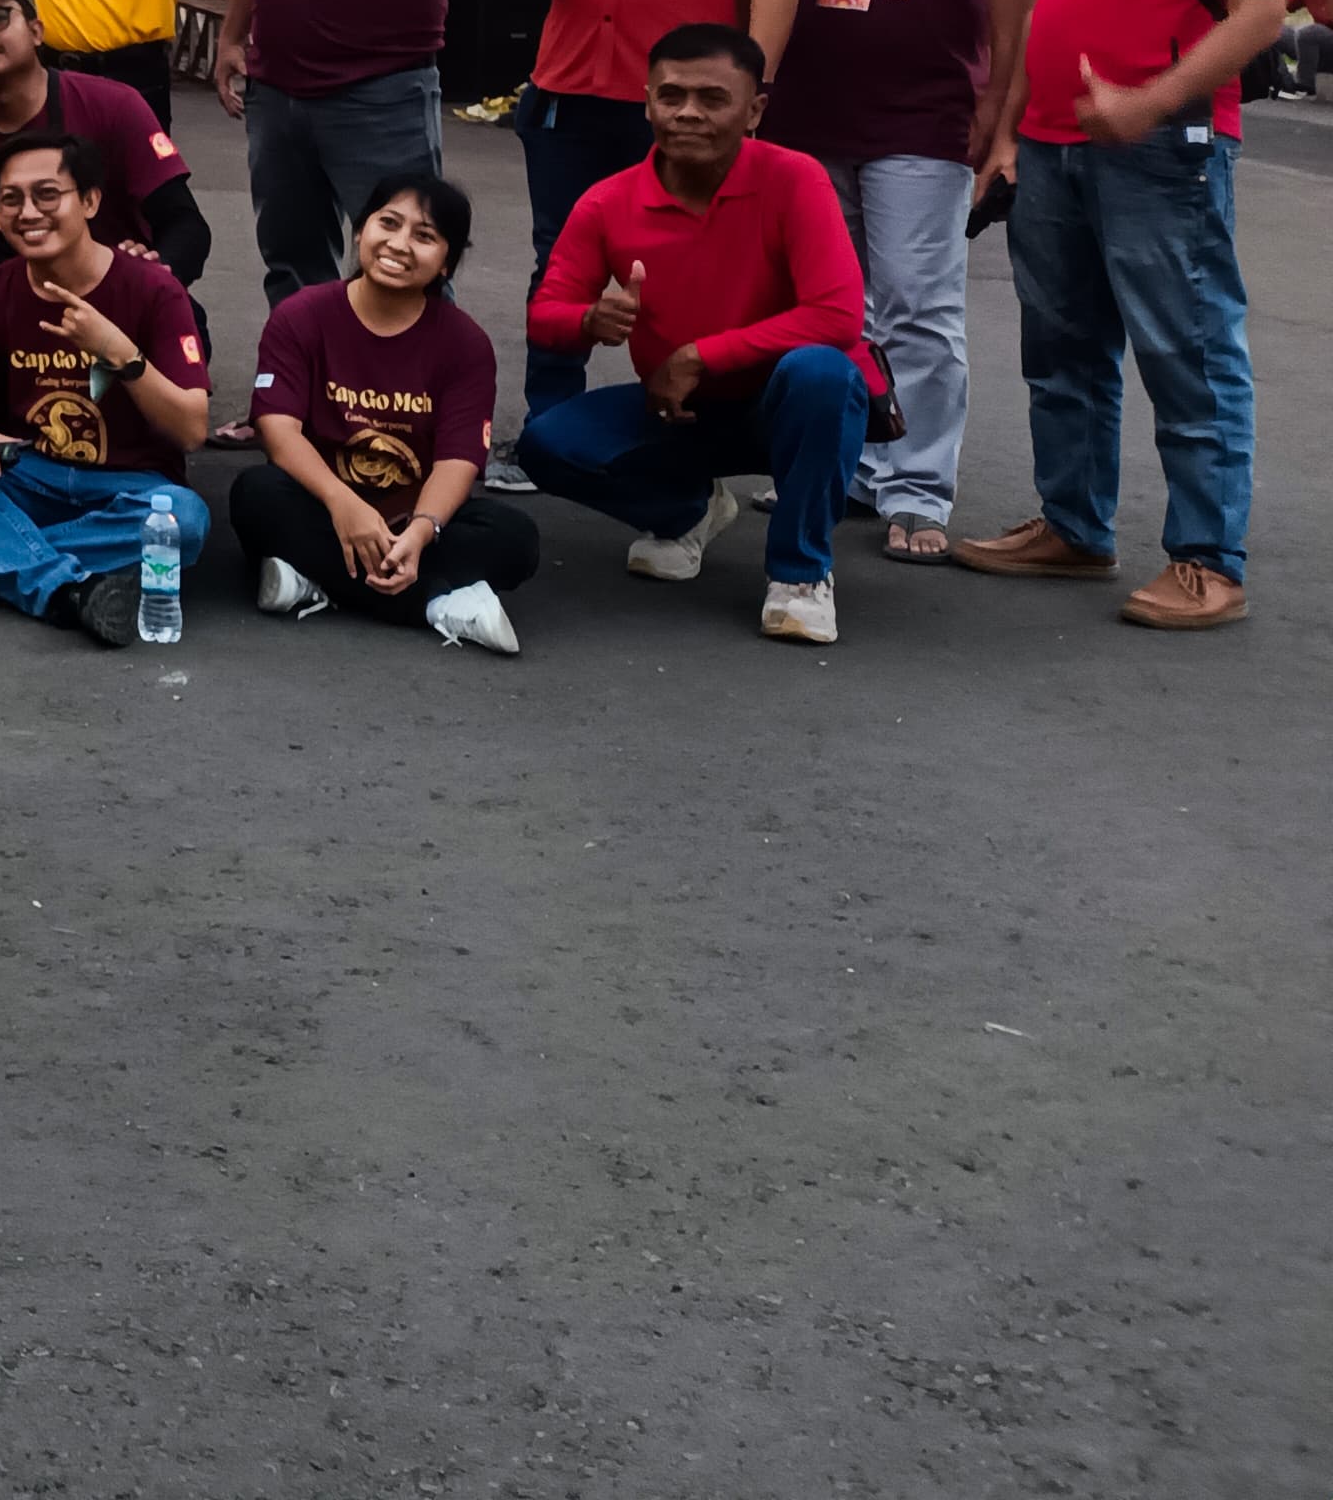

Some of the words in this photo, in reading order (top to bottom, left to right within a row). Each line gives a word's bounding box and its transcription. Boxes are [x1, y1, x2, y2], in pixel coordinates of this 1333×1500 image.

[10, 350, 50, 374] Cap
[53, 350, 77, 369] Go
[326, 380, 357, 410] Cap
[360, 389, 389, 411] Go
[394, 391, 432, 413] Meh
